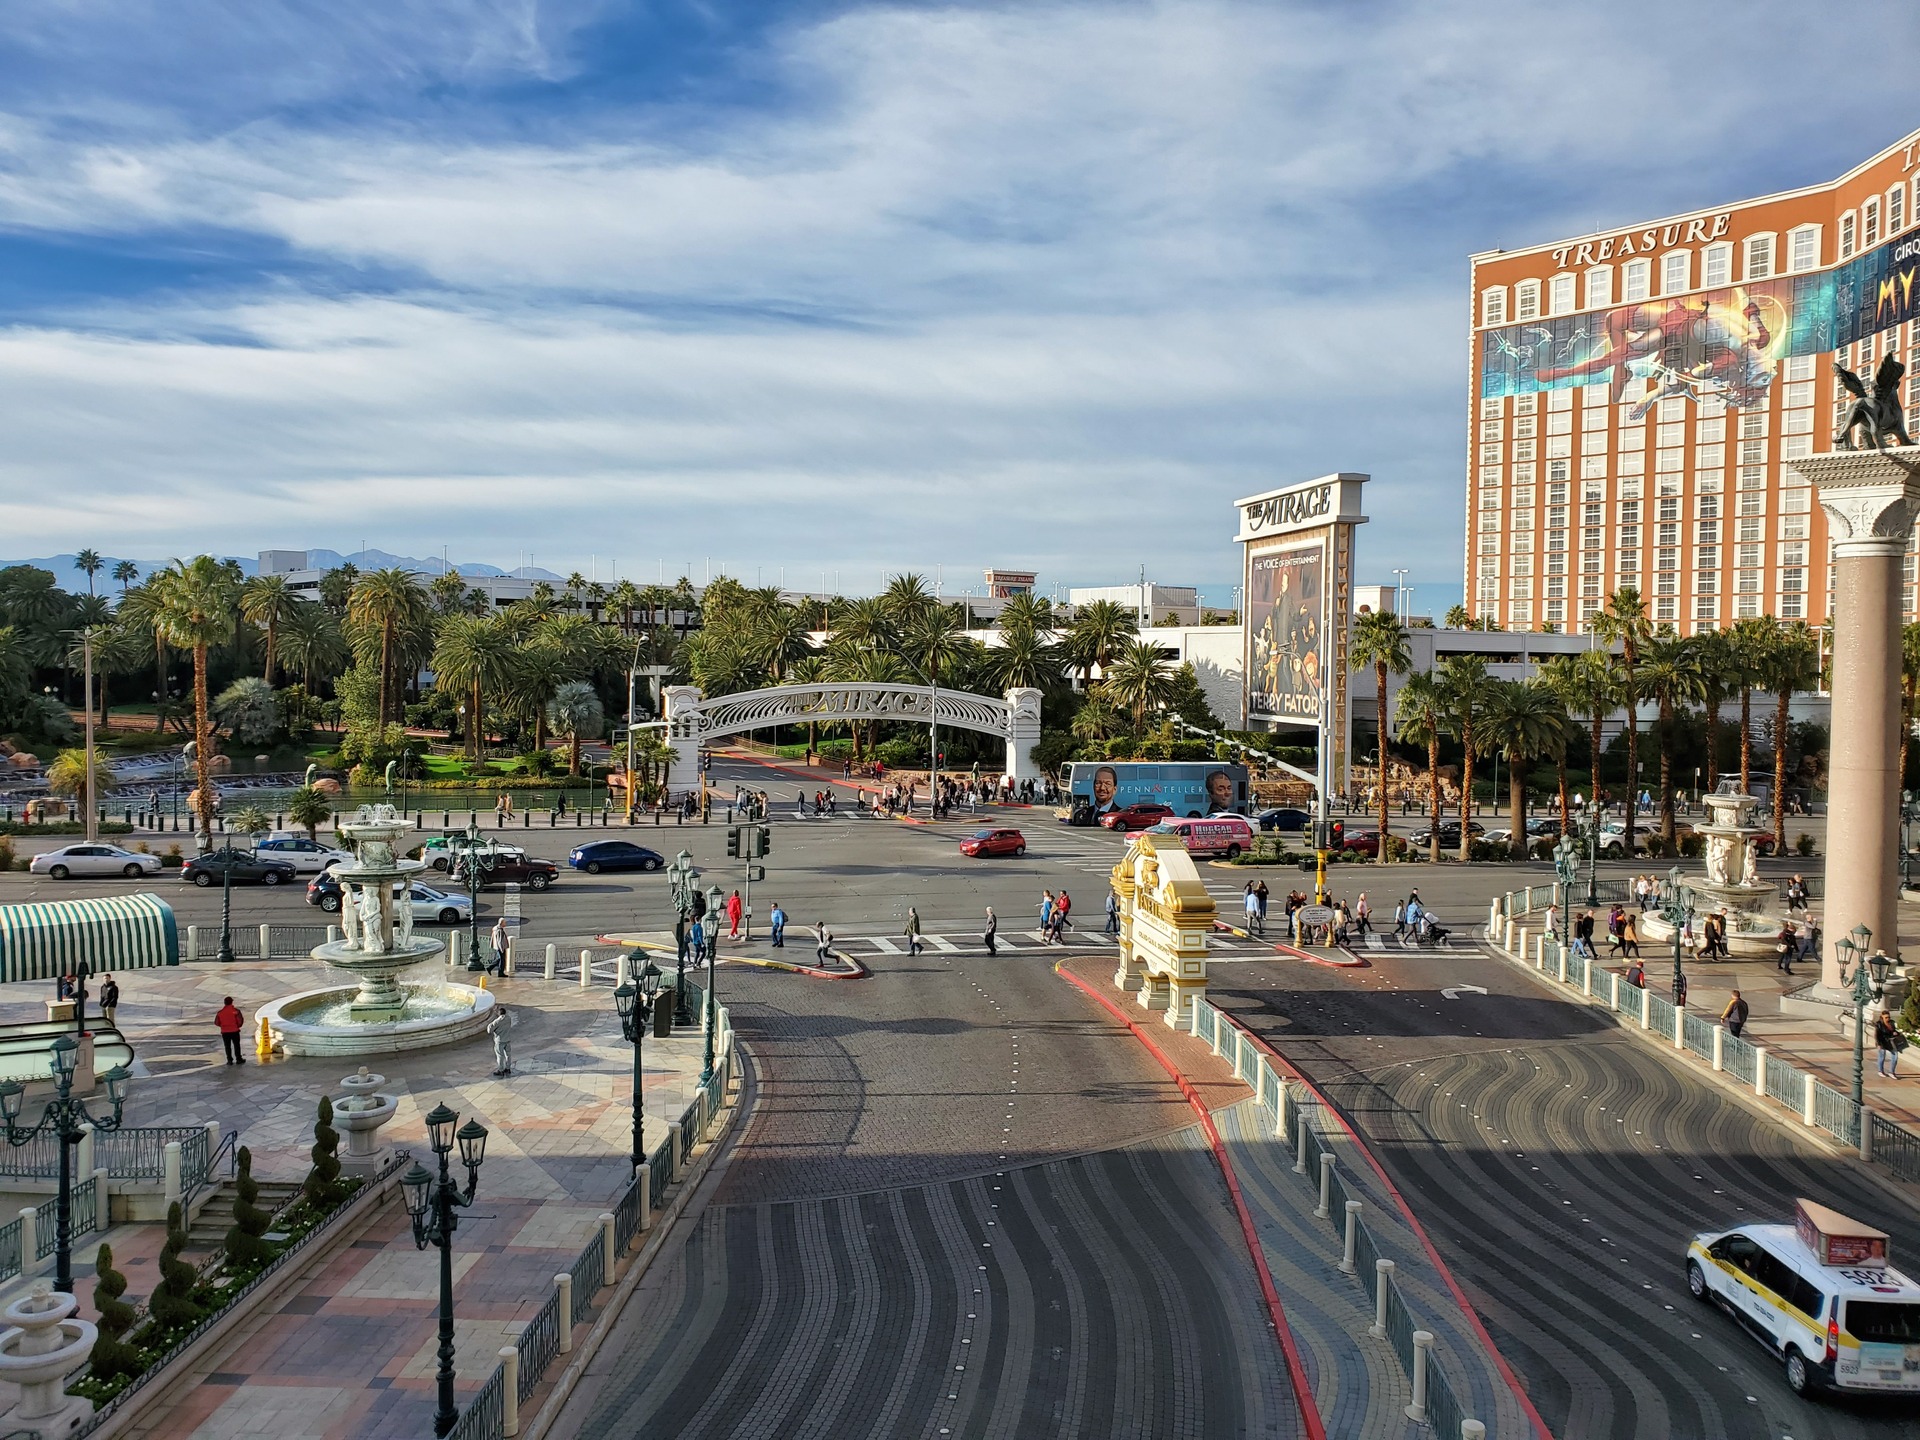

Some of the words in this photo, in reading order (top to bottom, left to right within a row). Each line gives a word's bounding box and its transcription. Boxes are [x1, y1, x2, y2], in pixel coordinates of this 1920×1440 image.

[1552, 213, 1732, 269] TREASURE
[1877, 265, 1916, 322] MY
[1246, 502, 1263, 520] THE
[1249, 485, 1332, 532] MIRAGE
[1254, 562, 1263, 571] THE
[1263, 557, 1279, 569] VOICE
[1279, 560, 1285, 568] OF
[1285, 554, 1320, 567] ENTERTAINMENT
[803, 690, 934, 715] MIRAGE
[1250, 690, 1283, 711] TERRY
[1284, 693, 1319, 715] FATOR
[1839, 1270, 1905, 1287] 5923
[1840, 1365, 1859, 1375] 5923
